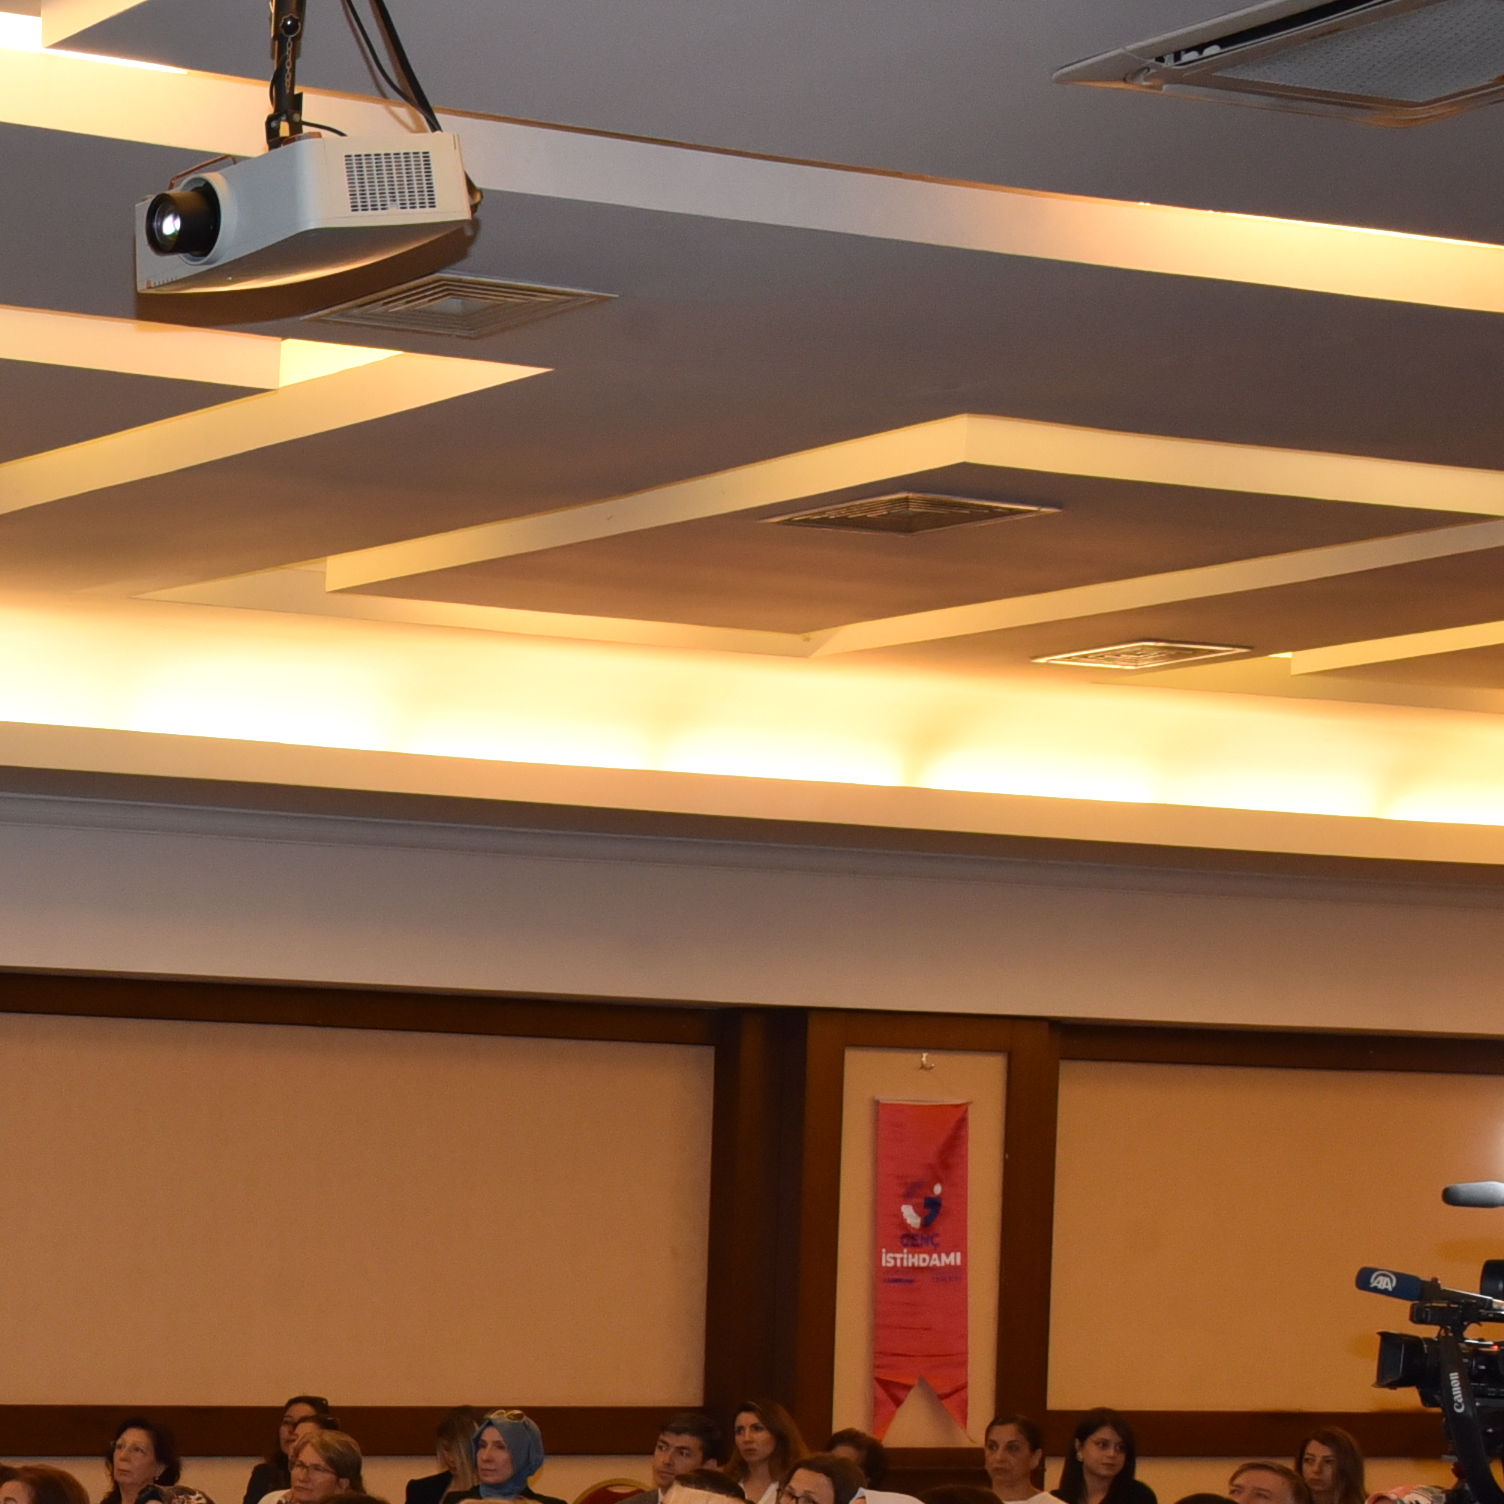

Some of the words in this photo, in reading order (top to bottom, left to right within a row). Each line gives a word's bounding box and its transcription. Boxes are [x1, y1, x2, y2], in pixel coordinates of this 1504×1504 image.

[900, 1232, 940, 1250] GENÇ
[881, 1248, 961, 1267] İSTİHDAMI
[1449, 1372, 1465, 1413] Canon
